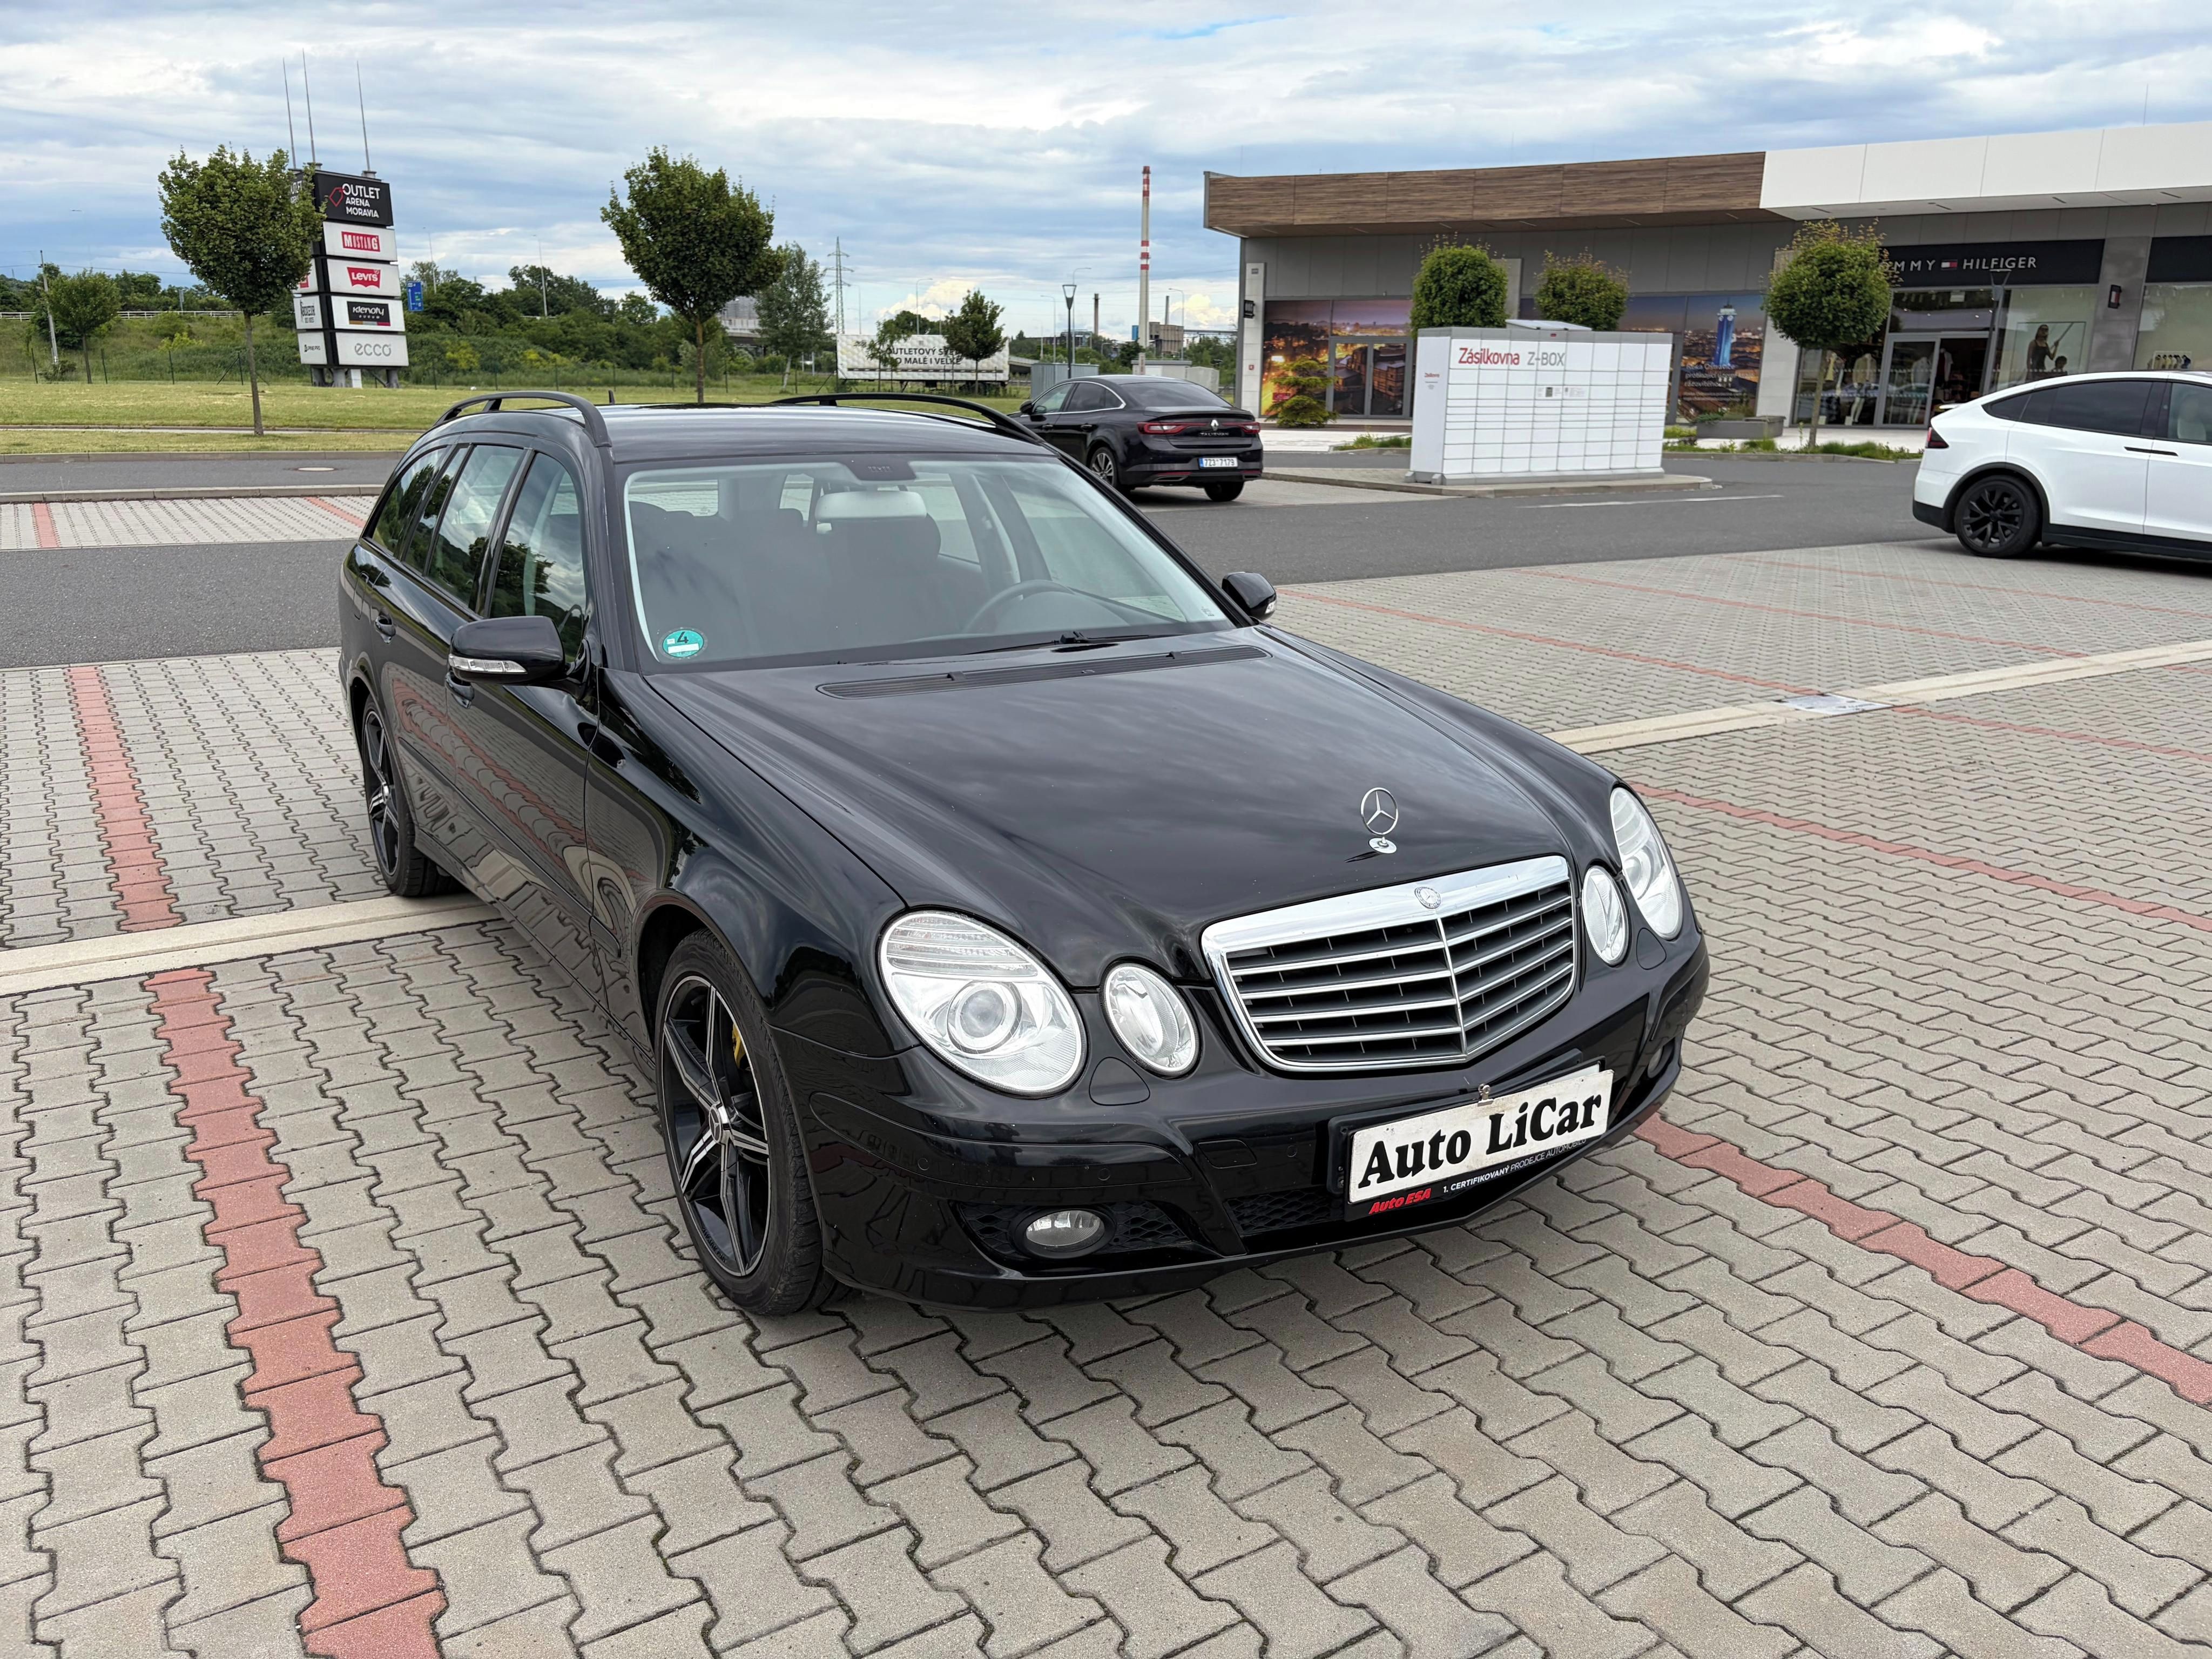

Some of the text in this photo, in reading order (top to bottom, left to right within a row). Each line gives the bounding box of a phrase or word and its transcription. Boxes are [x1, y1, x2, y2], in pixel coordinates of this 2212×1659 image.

[342, 183, 380, 199] OUTLET
[346, 197, 370, 207] ARENA
[346, 206, 380, 218] MORAVIA
[343, 234, 379, 250] MUSTANG
[1963, 257, 2036, 269] HILFIGER
[354, 343, 392, 357] ecco
[1458, 347, 1566, 366] Zásilkovna Z-BOX
[904, 356, 928, 365] MALÉ
[677, 631, 689, 643] 4
[1358, 1094, 1602, 1189] Auto LiCar
[1450, 1164, 1510, 1191] CERTIFIKOVANÝ
[1510, 1151, 1546, 1172] PRODEJCE
[1369, 1188, 1432, 1215] Auto ESA
